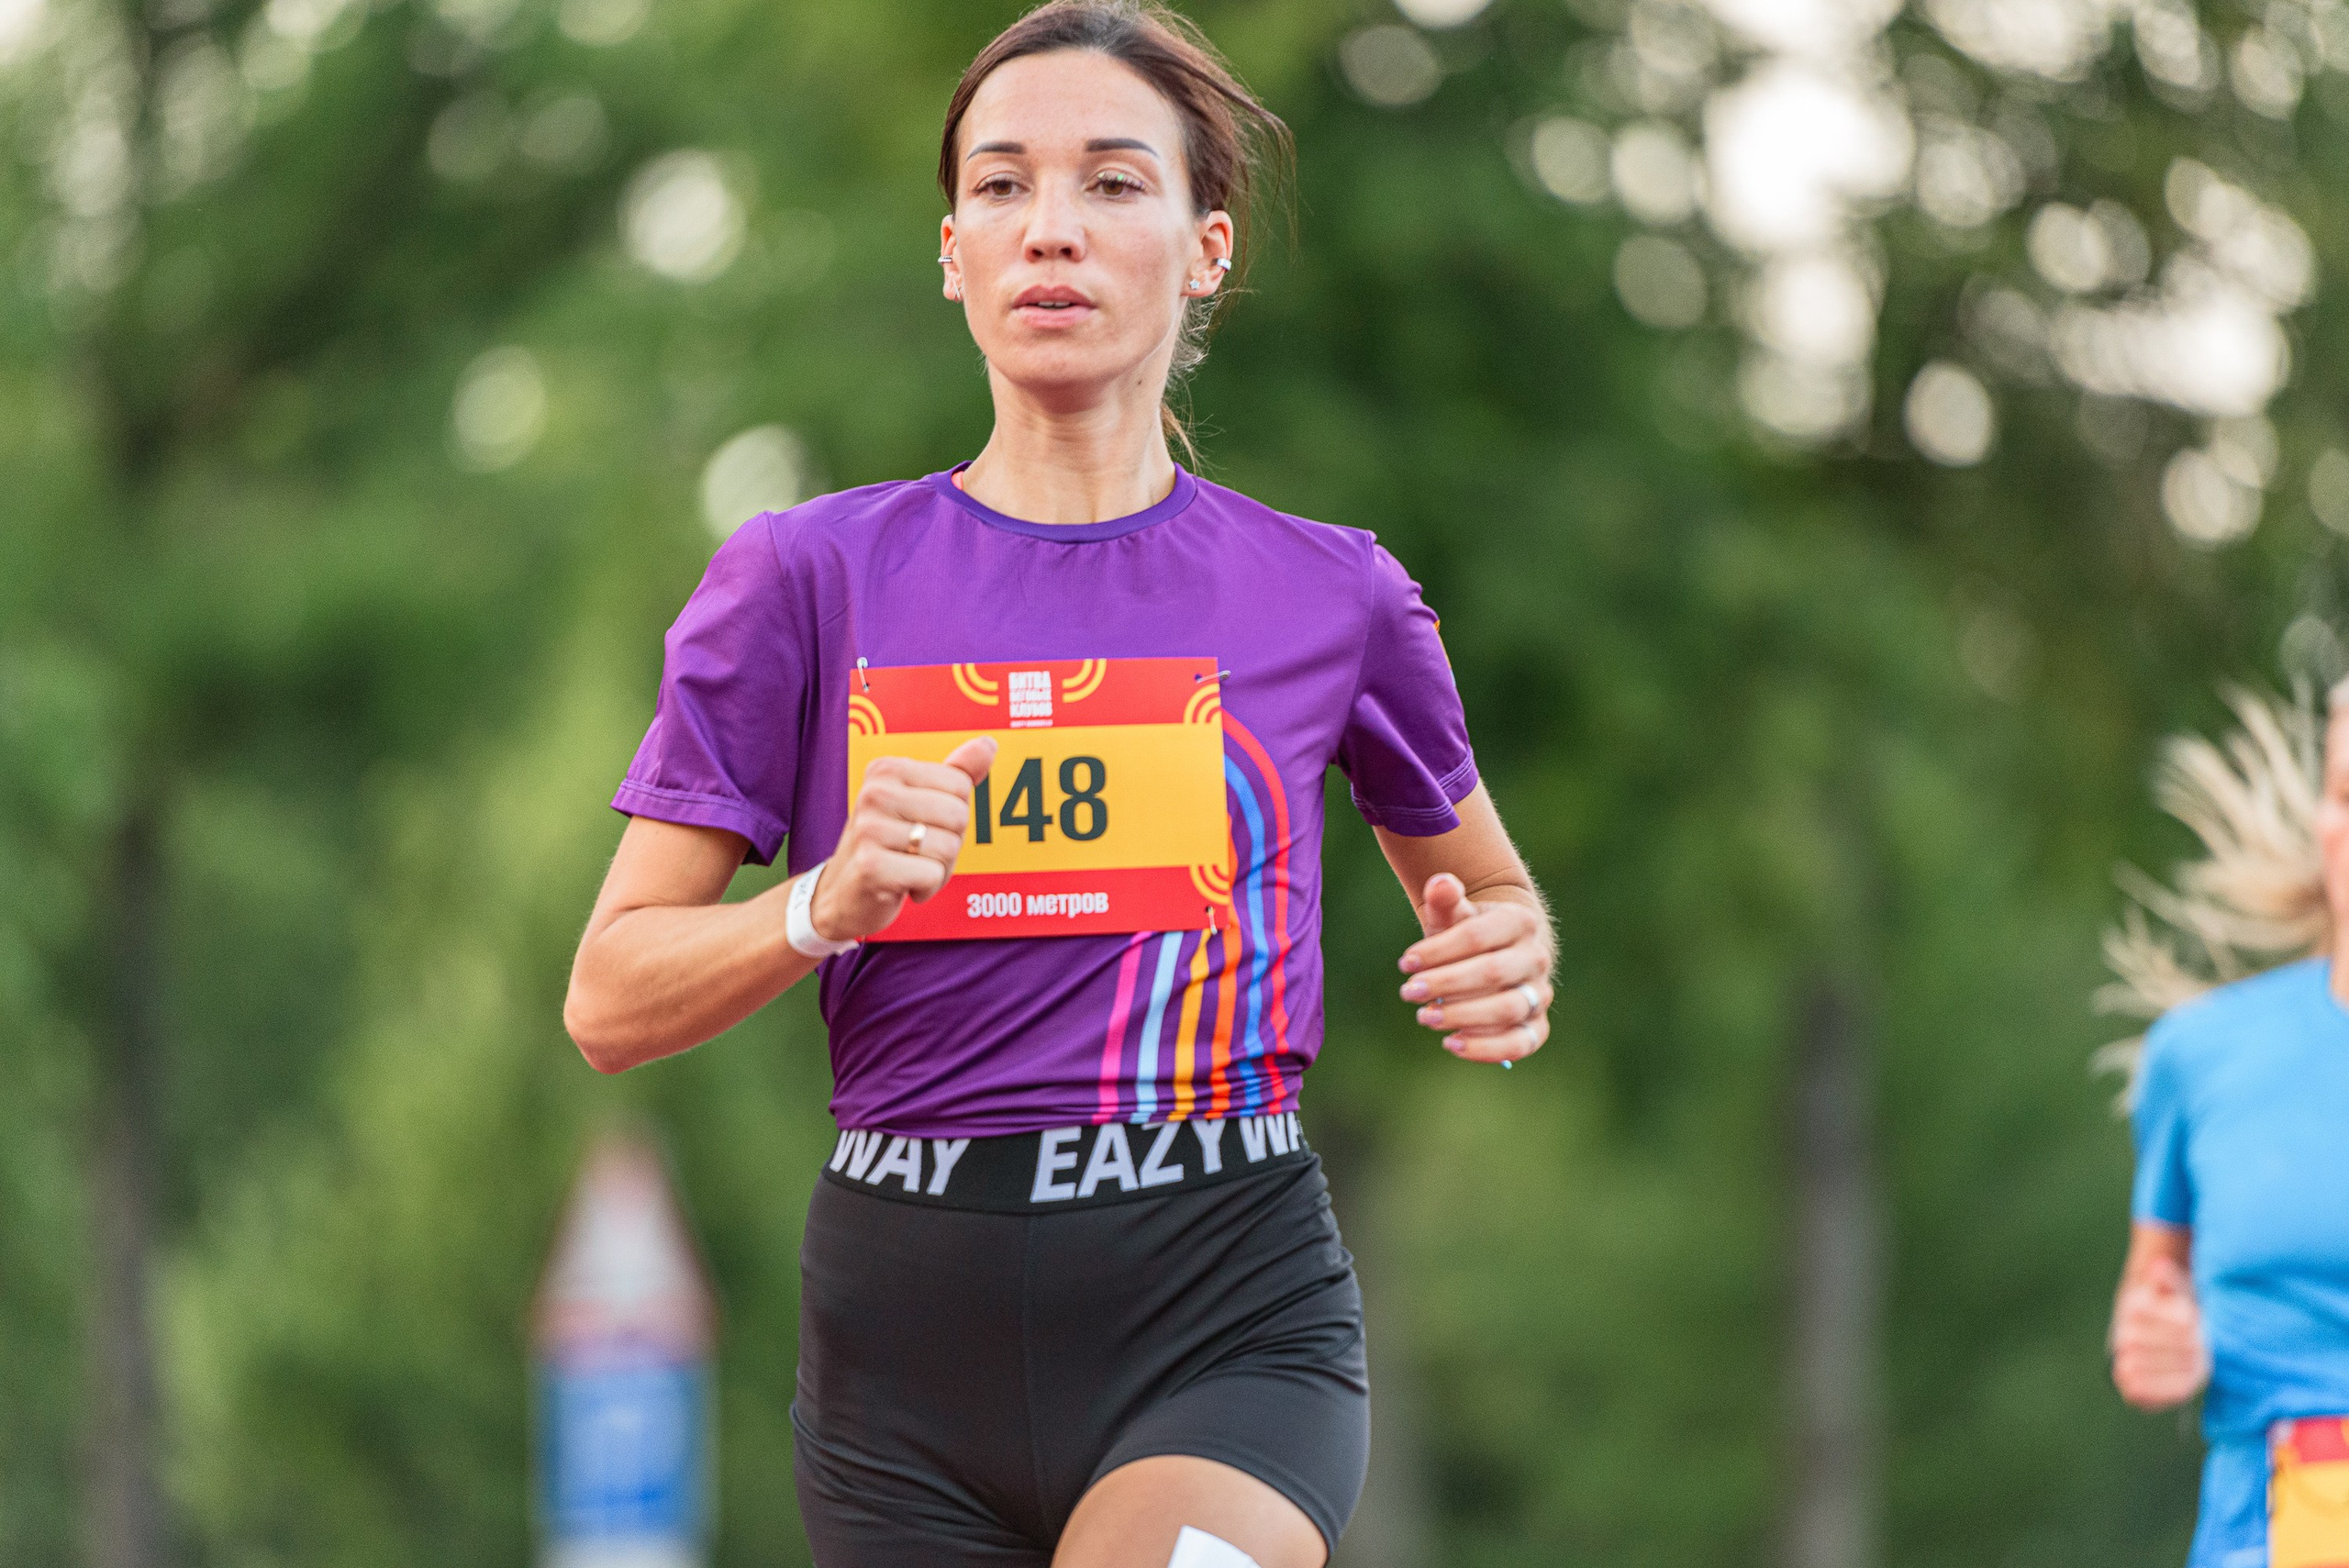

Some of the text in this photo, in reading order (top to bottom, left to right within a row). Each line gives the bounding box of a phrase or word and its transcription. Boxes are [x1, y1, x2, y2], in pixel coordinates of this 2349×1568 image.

[974, 755, 1108, 845] 148
[966, 891, 1109, 918] 3000 метров
[829, 1129, 973, 1196] WAY
[1030, 1116, 1228, 1204] EAZY
